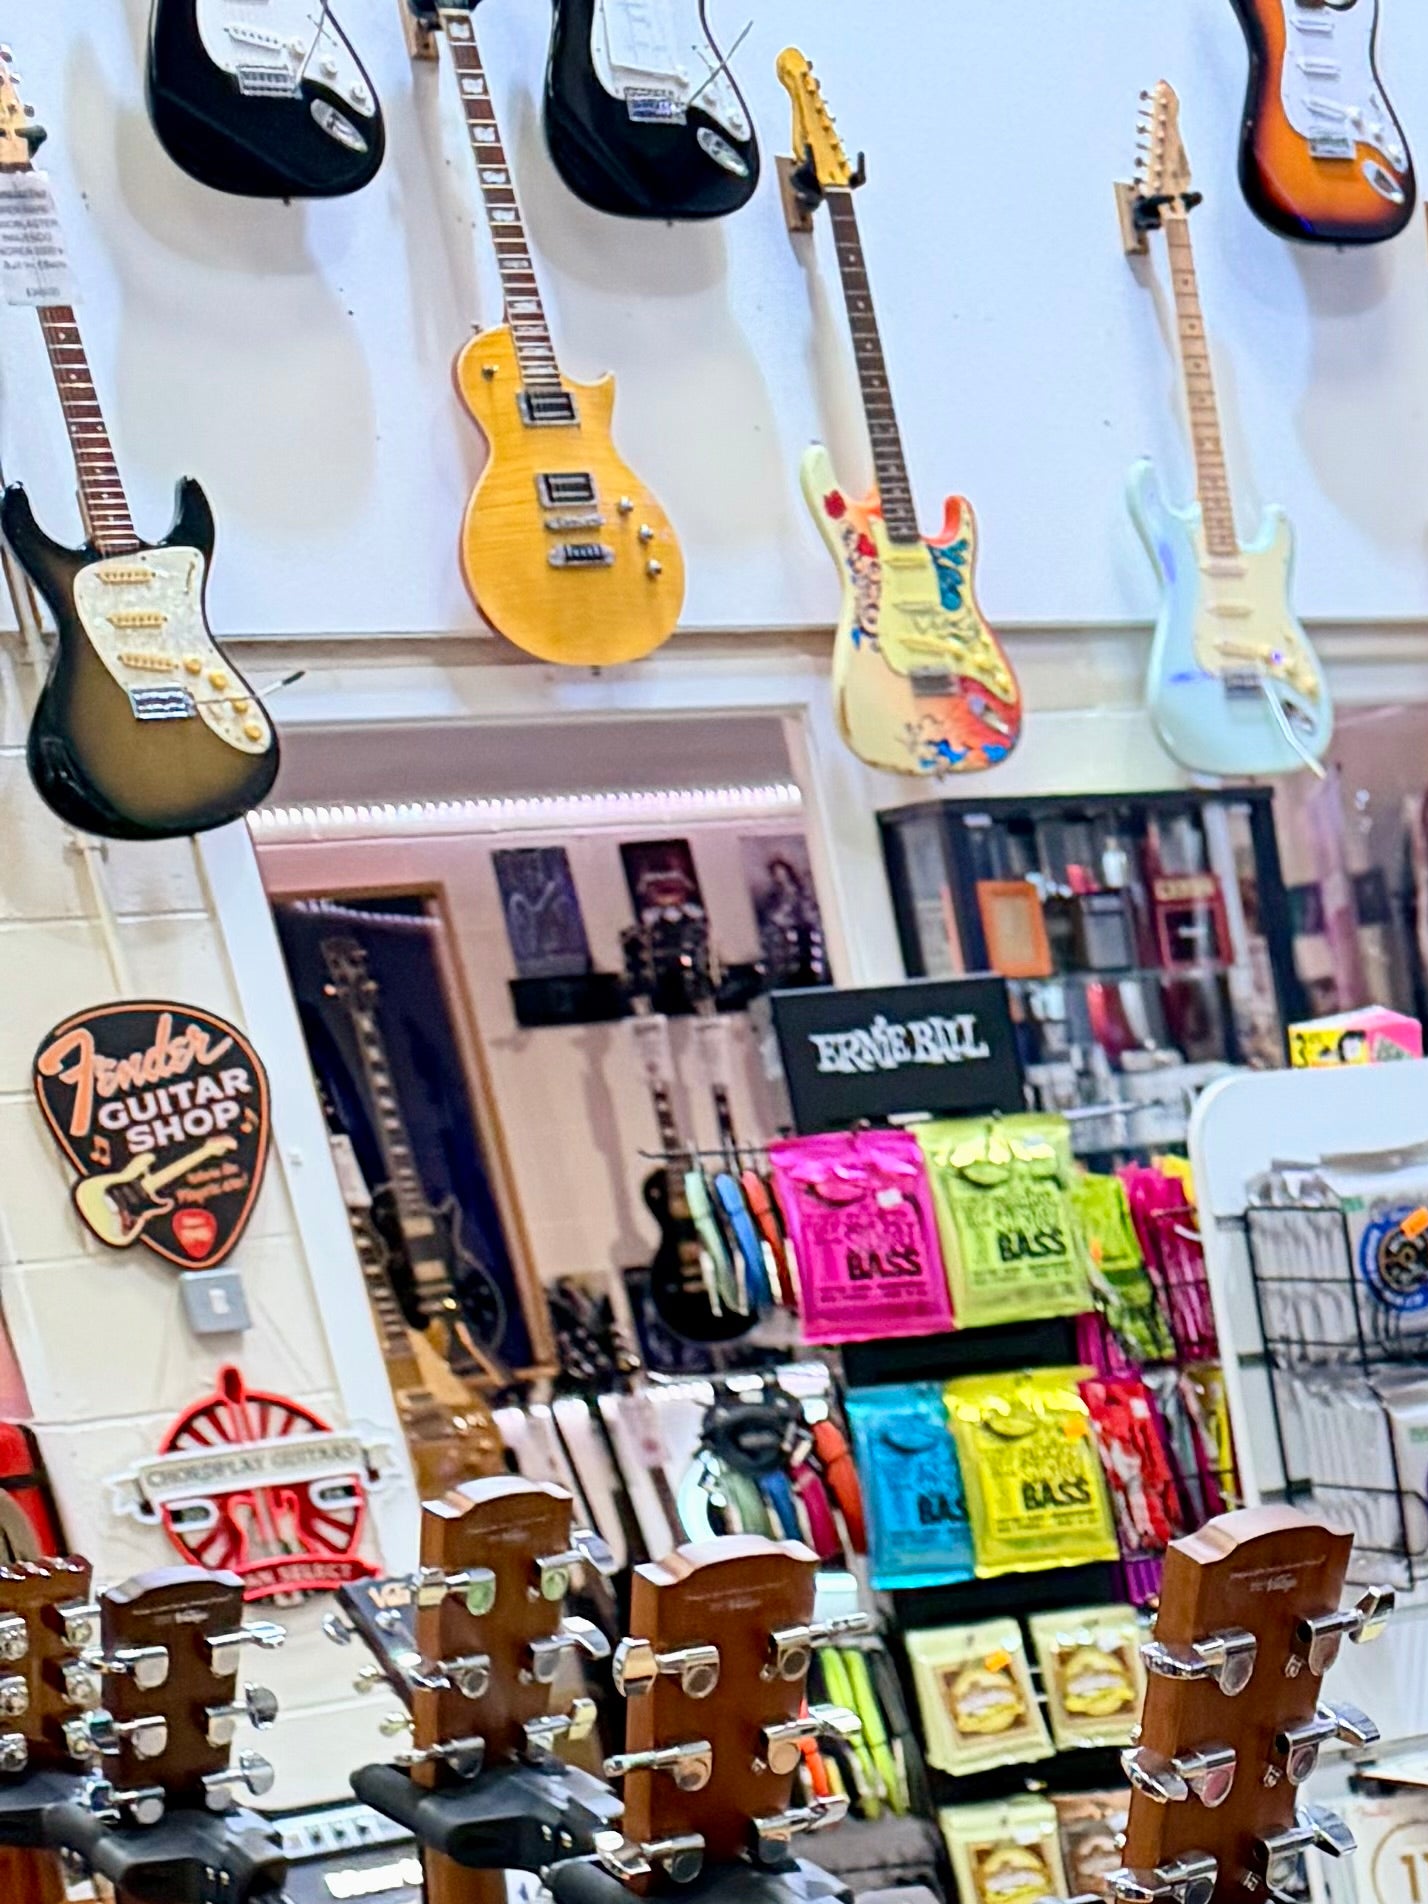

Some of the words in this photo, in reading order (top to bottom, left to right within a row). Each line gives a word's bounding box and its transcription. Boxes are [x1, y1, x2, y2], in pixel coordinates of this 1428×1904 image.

[809, 1014, 908, 1074] ERNIE
[911, 1014, 990, 1064] BALL
[37, 1013, 233, 1136] Fender
[98, 1067, 252, 1130] GUITAR
[126, 1100, 240, 1153] SHOP
[847, 1247, 923, 1282] BASS
[999, 1227, 1066, 1263] BASS
[1022, 1475, 1093, 1511] BASS
